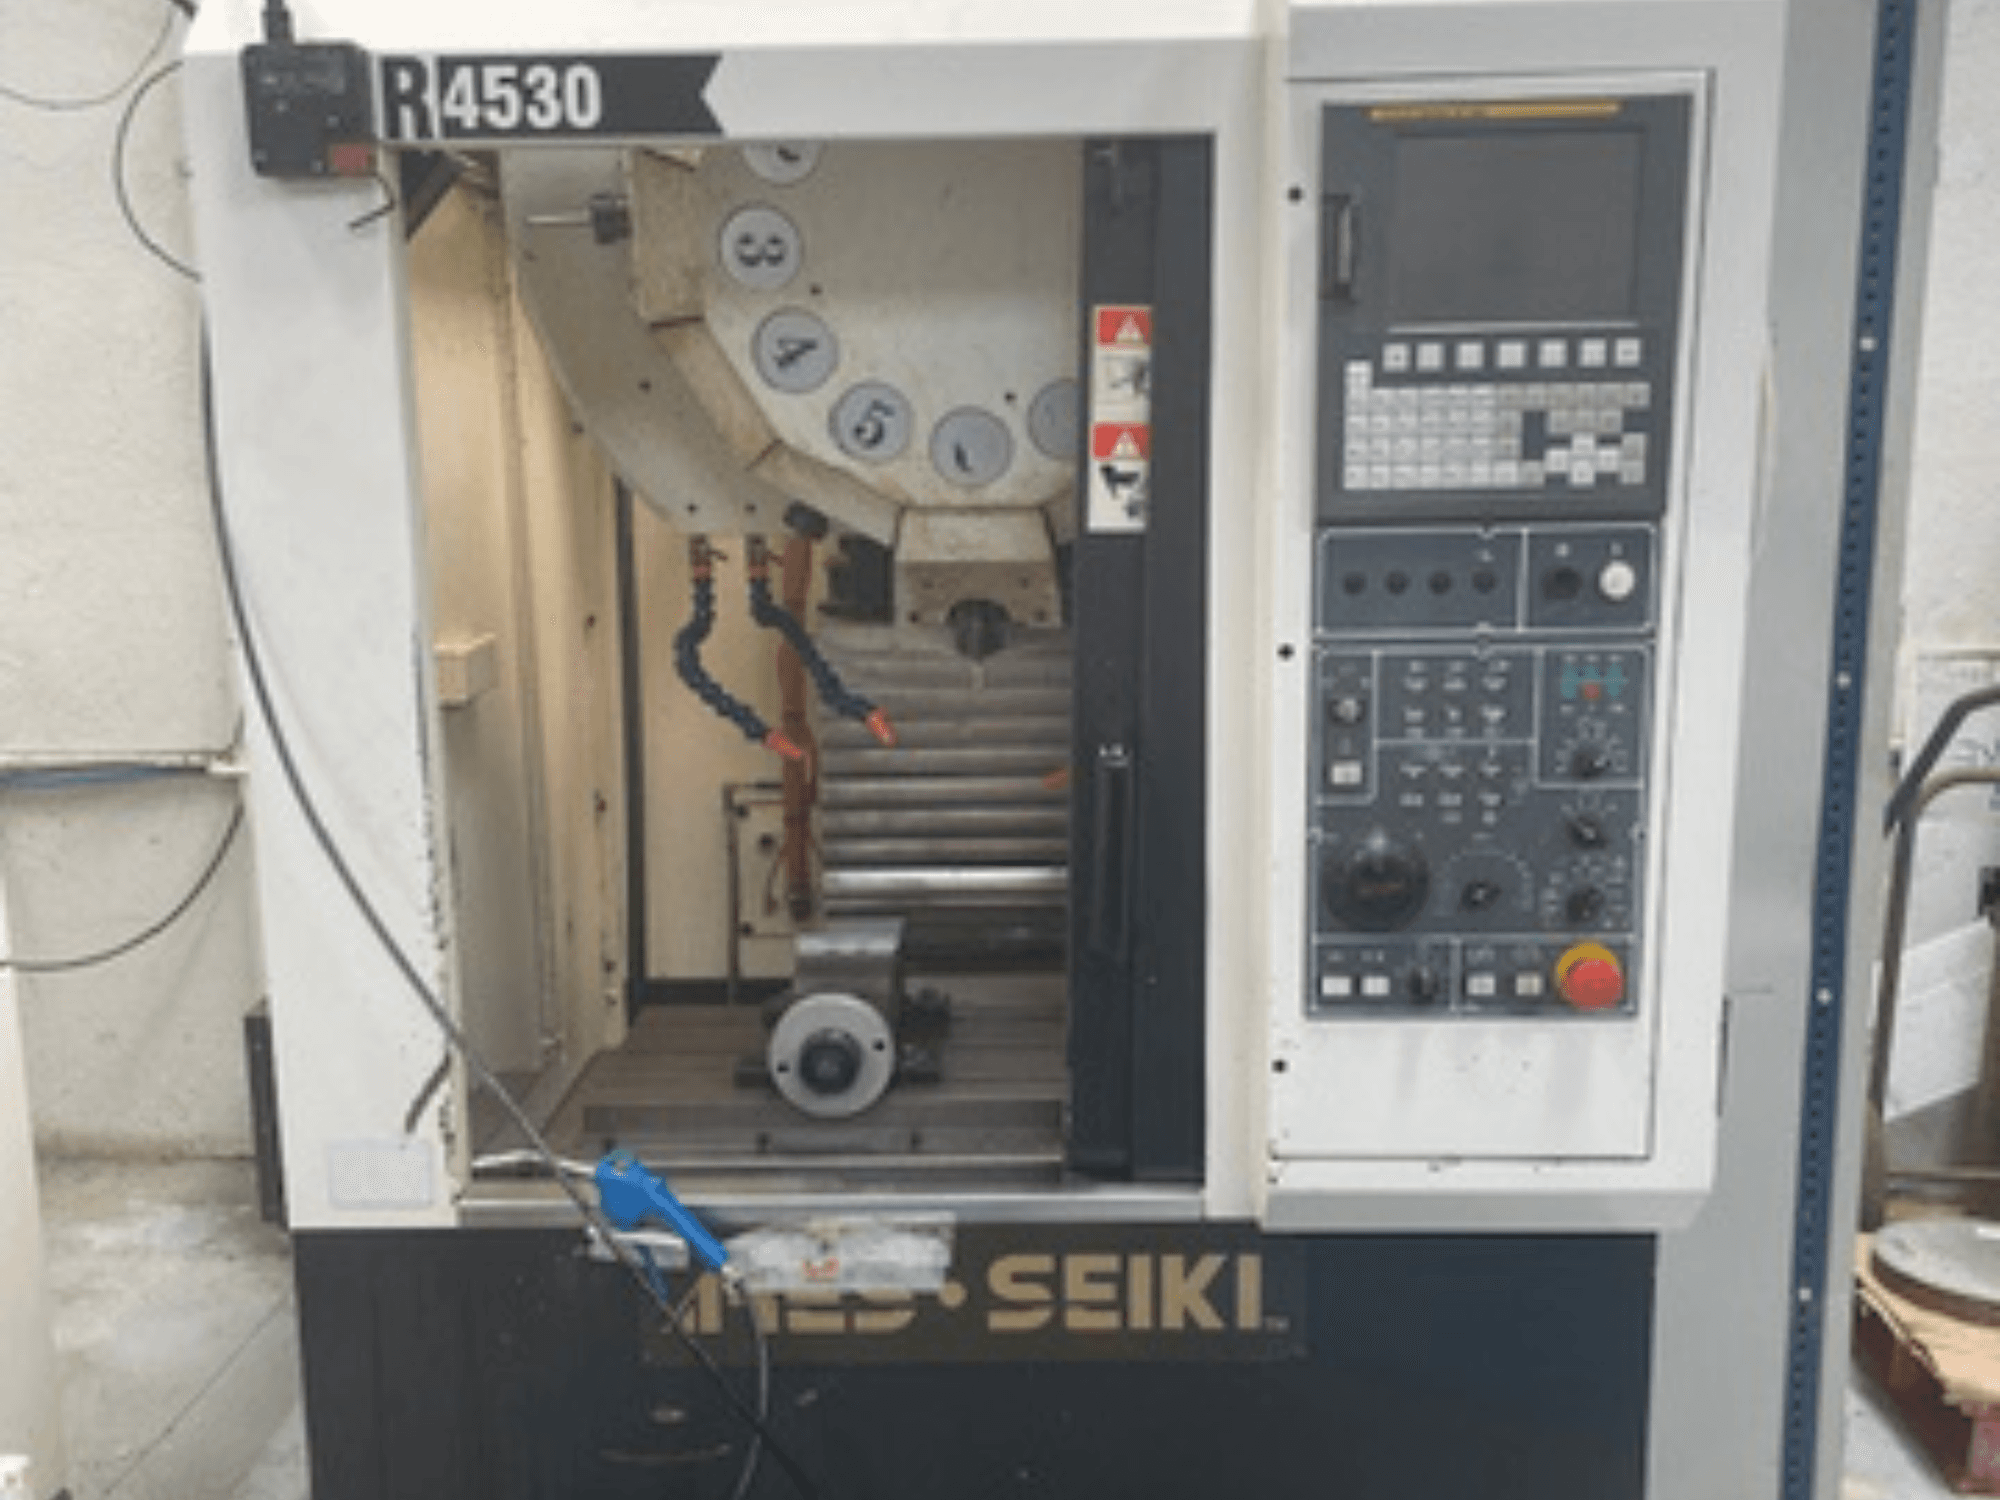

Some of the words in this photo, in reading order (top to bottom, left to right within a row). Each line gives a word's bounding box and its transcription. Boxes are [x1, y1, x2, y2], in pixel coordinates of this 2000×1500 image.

[443, 65, 601, 129] 4530
[737, 234, 787, 268] 3
[774, 338, 818, 369] 4
[853, 399, 897, 448] 5
[988, 1255, 1263, 1330] SEIKI
